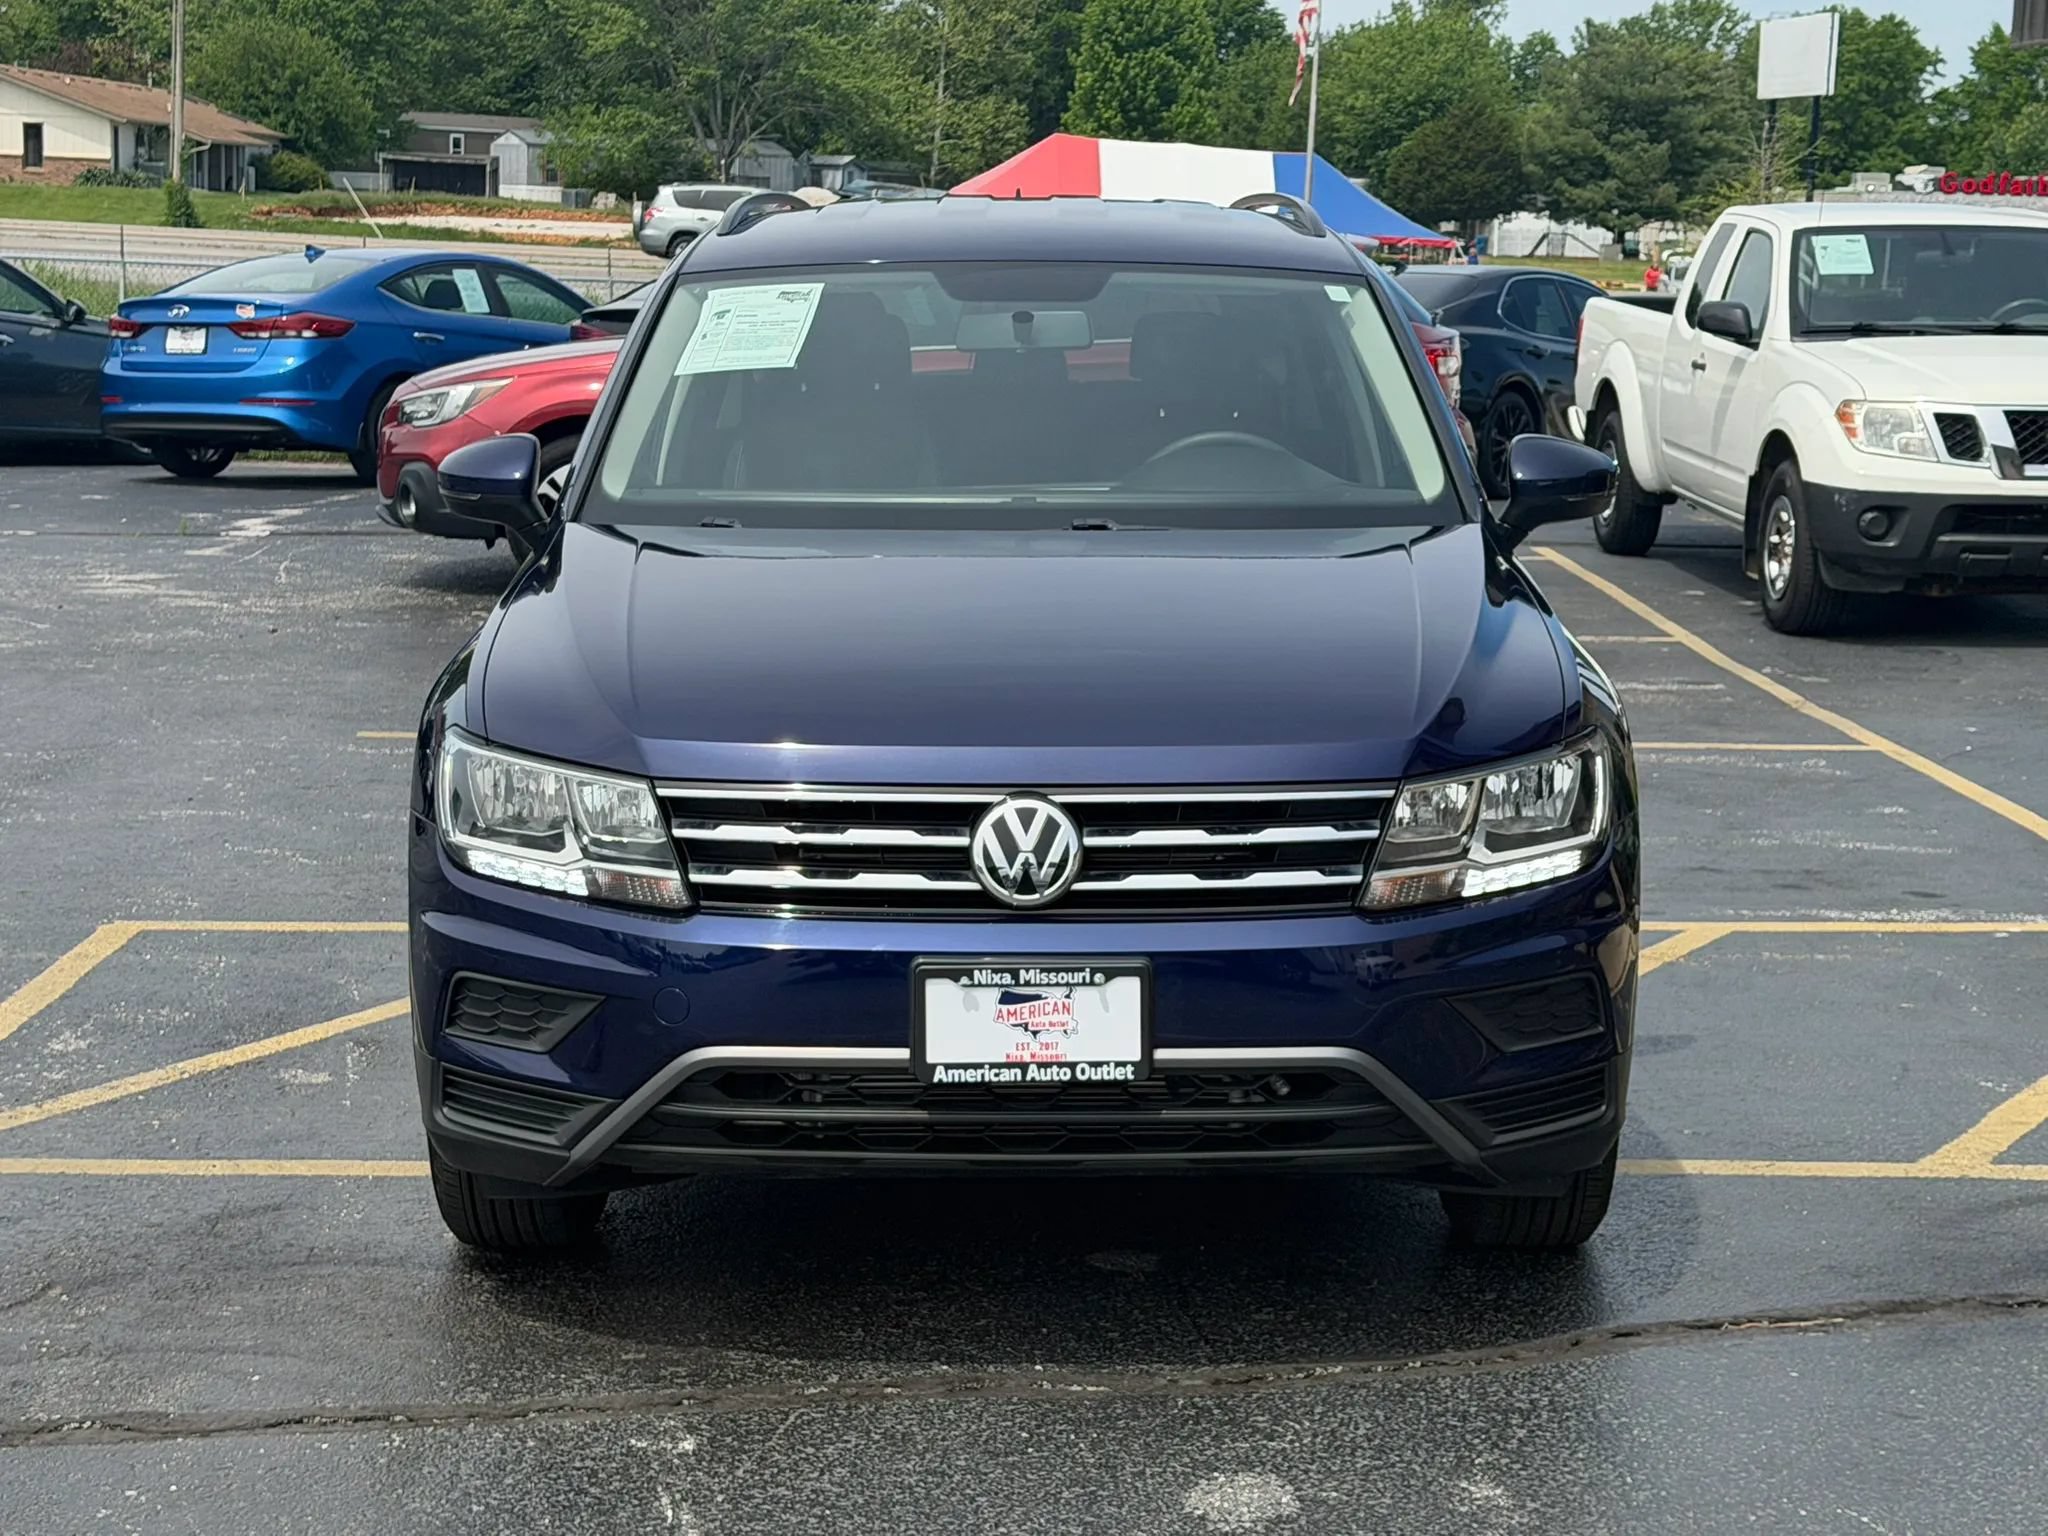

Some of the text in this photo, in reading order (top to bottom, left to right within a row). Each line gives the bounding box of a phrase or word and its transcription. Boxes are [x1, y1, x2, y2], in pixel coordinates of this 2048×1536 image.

[1019, 967, 1091, 984] Missouri
[996, 1001, 1071, 1022] AMERICAN
[1048, 1020, 1069, 1028] Outlet
[1039, 1042, 1059, 1051] 2017
[1030, 1052, 1067, 1061] Missouri
[933, 1062, 1135, 1083] American Auto Outlet
